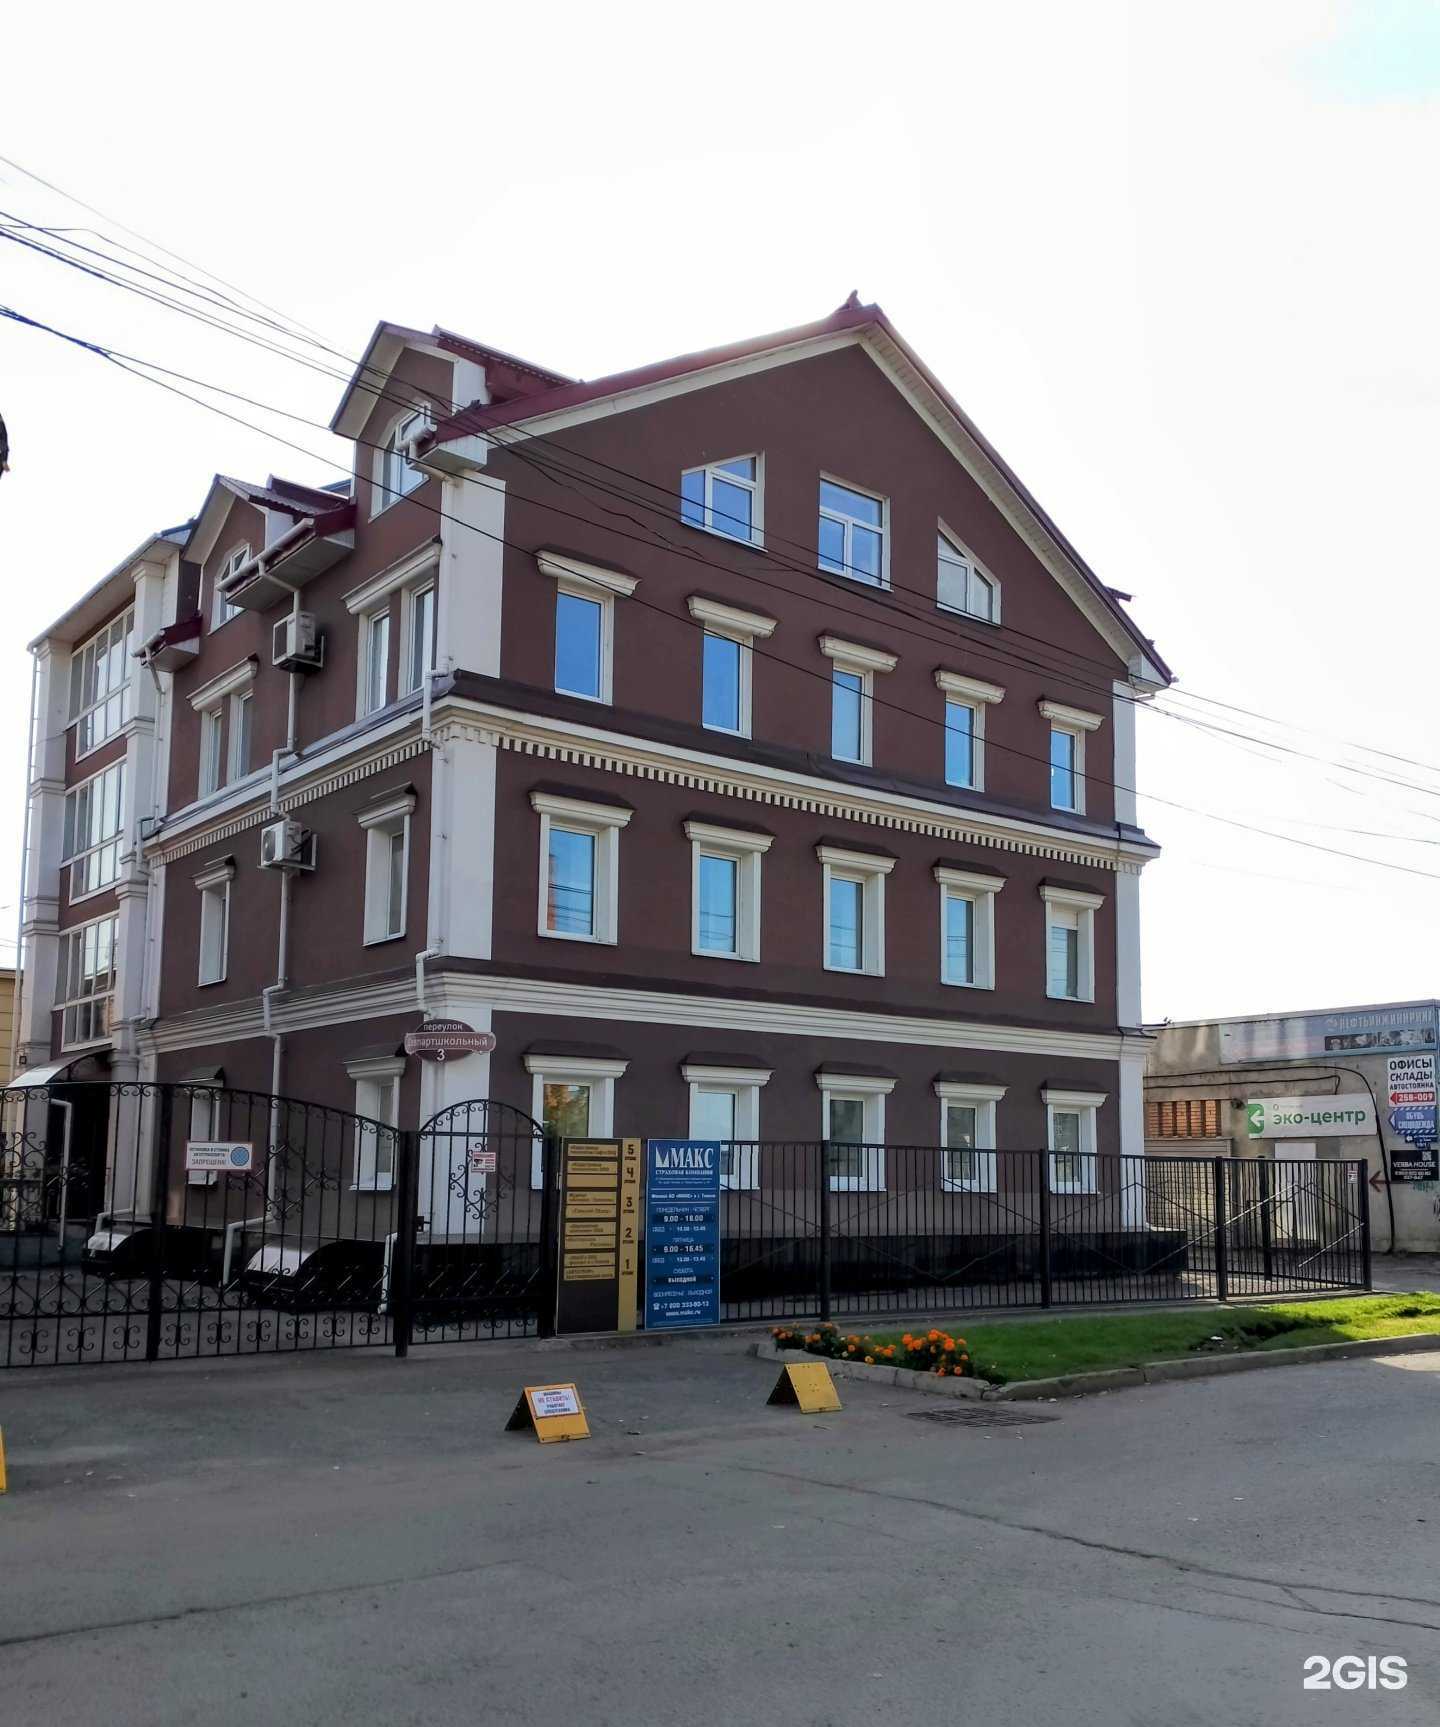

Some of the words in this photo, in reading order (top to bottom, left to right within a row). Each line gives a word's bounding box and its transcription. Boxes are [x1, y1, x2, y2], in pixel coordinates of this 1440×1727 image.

[423, 1023, 463, 1033] переулок
[436, 1048, 446, 1061] 3
[1389, 1058, 1432, 1071] ОФИСЫ
[1390, 1071, 1433, 1082] СКЛАДЫ
[1389, 1082, 1434, 1090] АВТОСТОЯНКА
[1398, 1093, 1433, 1101] 258-009
[1273, 1109, 1366, 1125] эко-центр
[627, 1143, 635, 1155] 5
[670, 1147, 714, 1169] МАКС
[626, 1167, 634, 1179] 4
[626, 1196, 633, 1208] 3
[663, 1215, 679, 1223] 9.00
[625, 1227, 633, 1239] 2
[625, 1258, 631, 1270] 1
